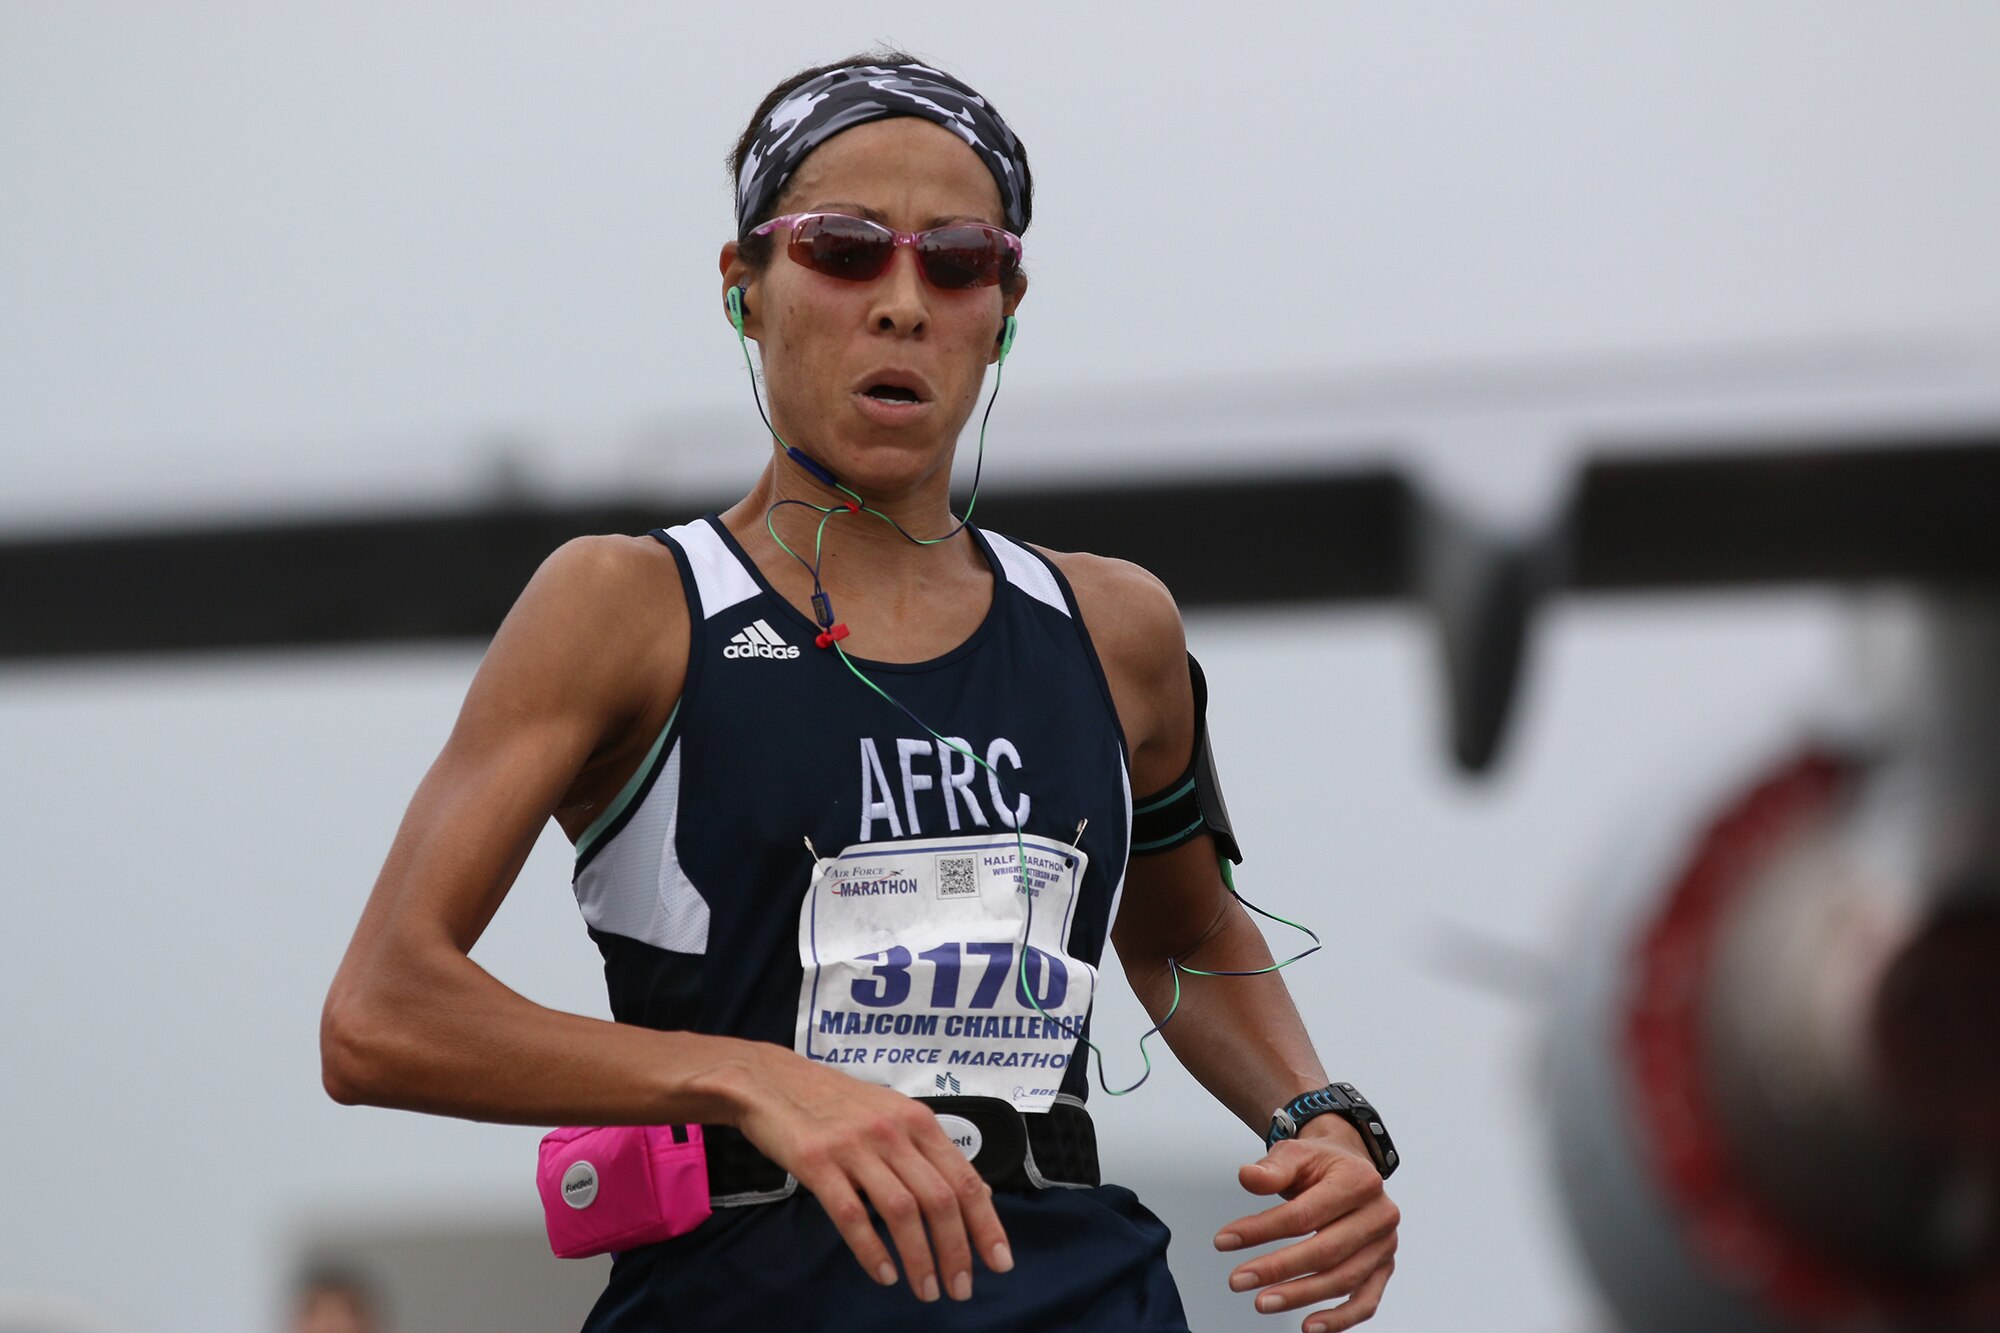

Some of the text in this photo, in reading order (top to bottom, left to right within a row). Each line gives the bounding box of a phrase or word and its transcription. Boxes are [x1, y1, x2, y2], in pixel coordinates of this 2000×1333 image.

[723, 641, 801, 660] adidas
[859, 736, 1031, 842] AFRC
[984, 854, 1016, 866] HALF
[831, 867, 885, 878] AIR FORCE
[840, 879, 917, 897] MARATHON
[850, 942, 1069, 1010] 3170
[819, 1010, 1084, 1040] MAJCOM CHALLENGE
[825, 1048, 867, 1063] AIR
[873, 1048, 942, 1063] FORCE
